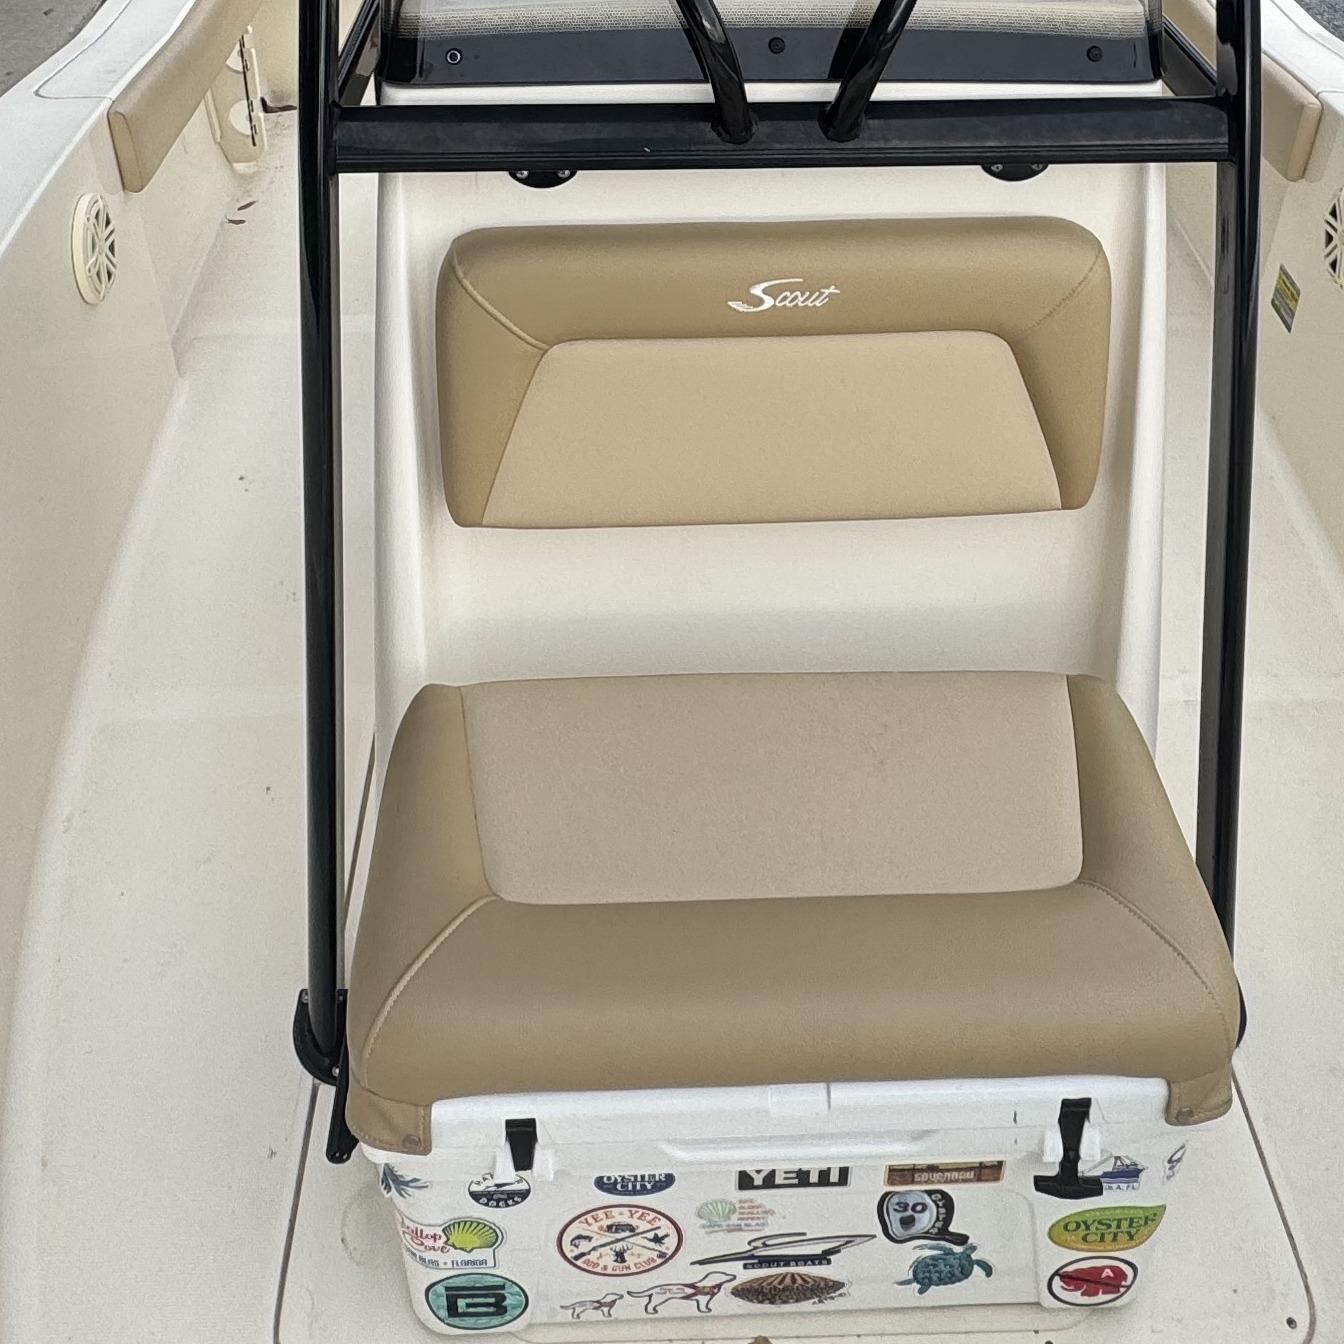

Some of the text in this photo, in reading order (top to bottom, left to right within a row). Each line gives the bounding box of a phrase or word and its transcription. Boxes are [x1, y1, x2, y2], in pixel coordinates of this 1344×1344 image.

[727, 278, 841, 312] Scout
[603, 1173, 666, 1185] OYSTER
[745, 1167, 840, 1186] YETI
[616, 1182, 655, 1191] CITY
[1081, 1229, 1141, 1244] CITY
[452, 1259, 488, 1267] FLORIDA
[612, 1264, 632, 1272] GUN
[635, 1258, 658, 1270] CLUB
[745, 1259, 828, 1269] SCOUT BOATS
[1101, 1268, 1114, 1279] A
